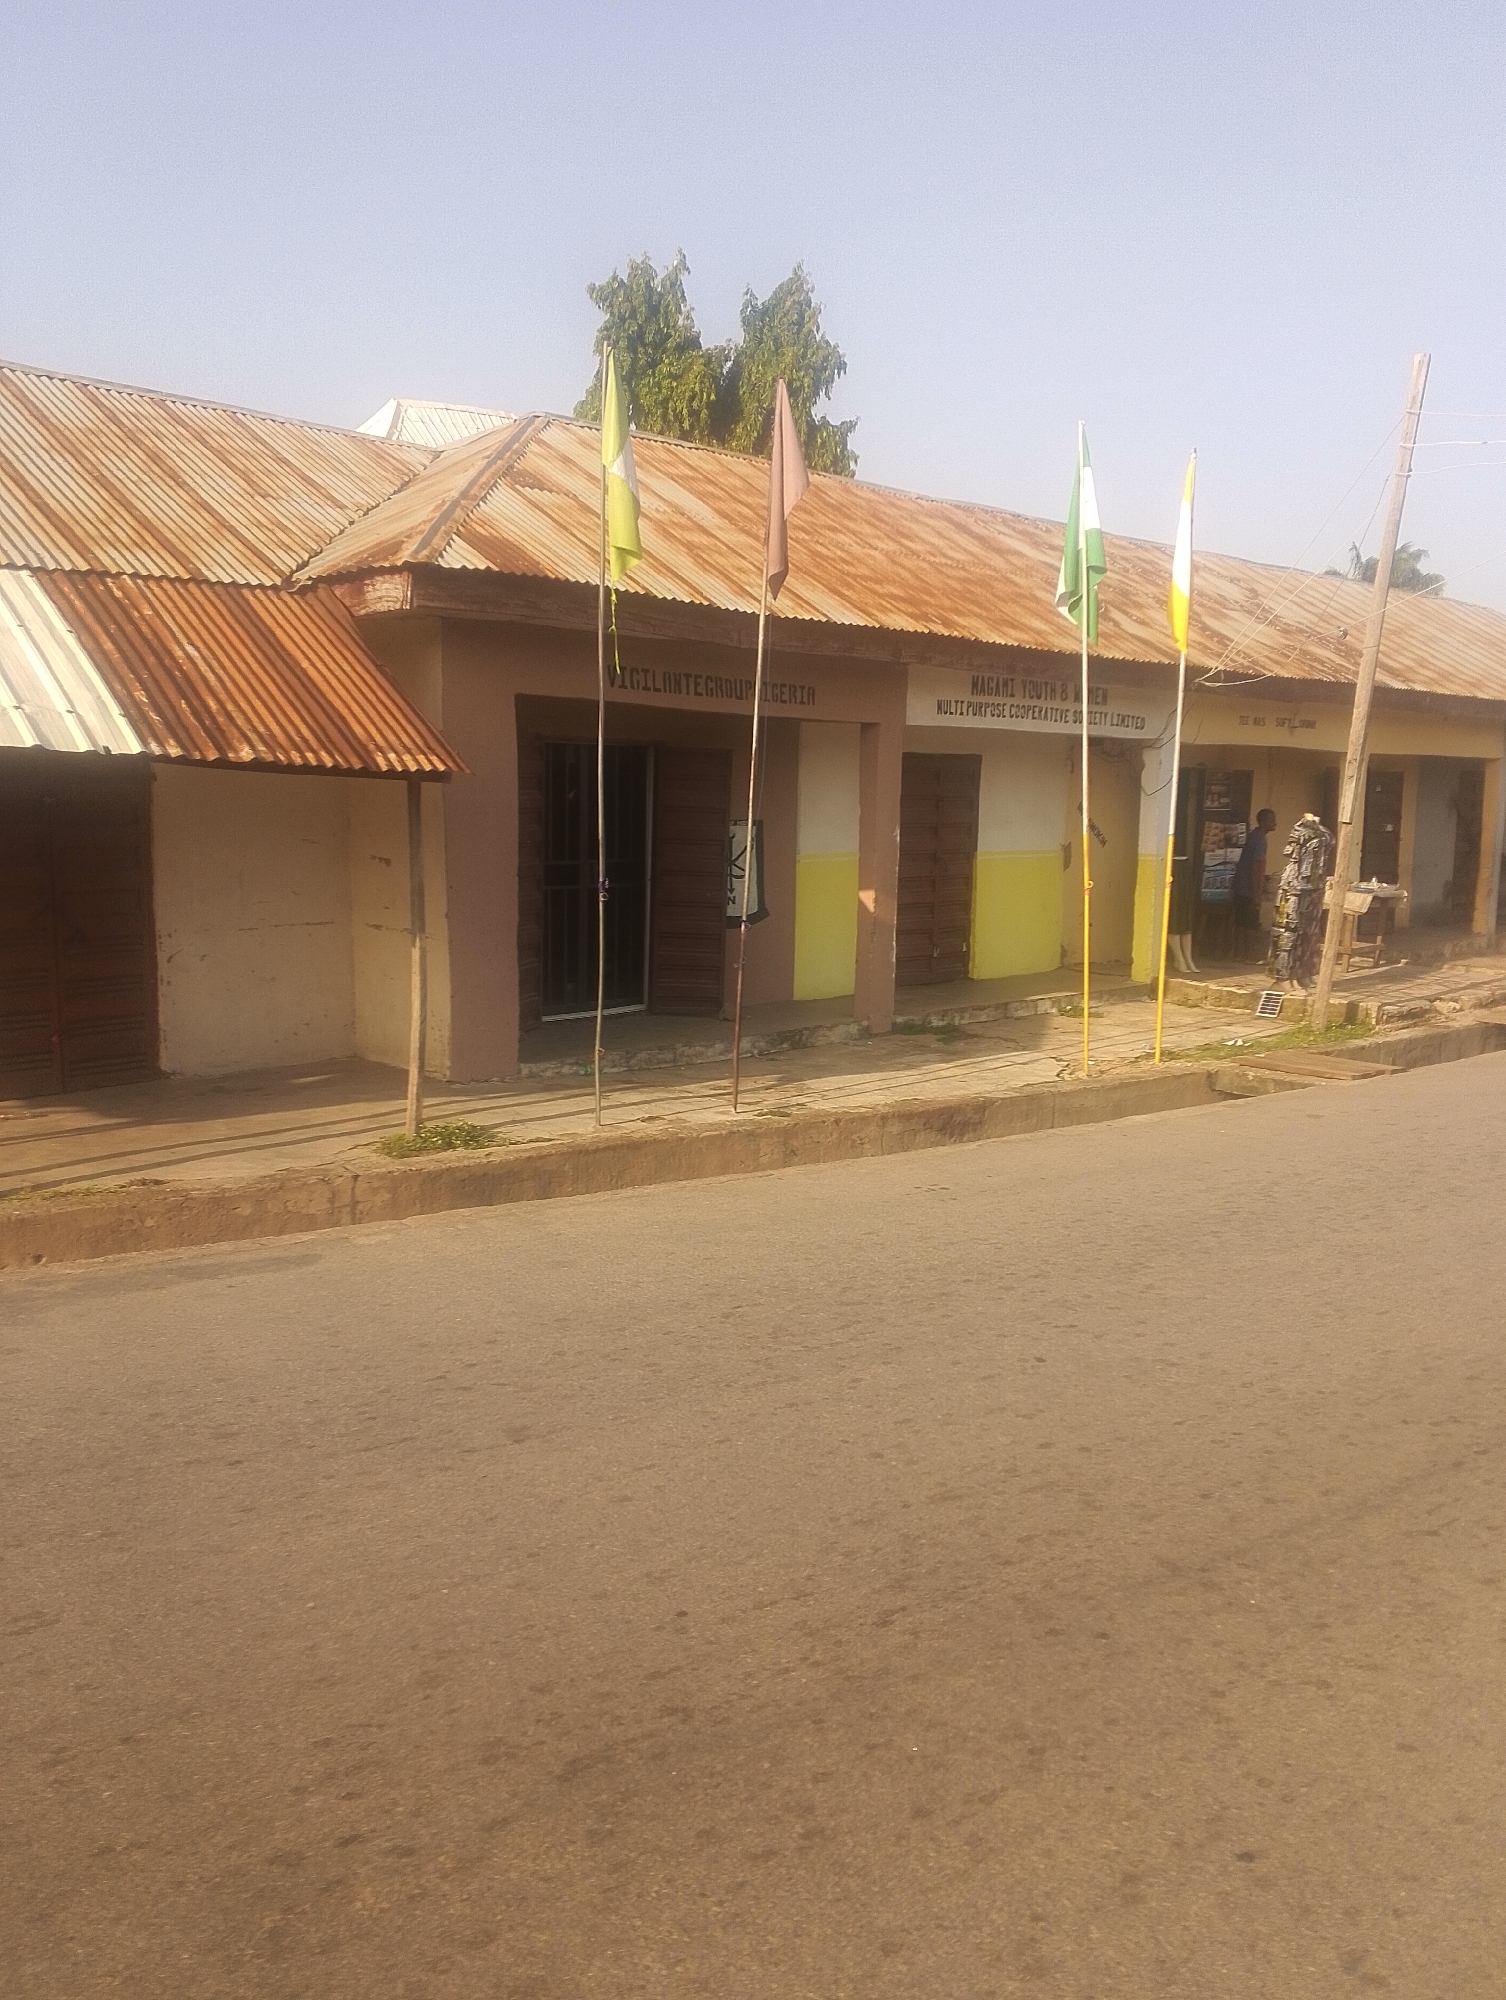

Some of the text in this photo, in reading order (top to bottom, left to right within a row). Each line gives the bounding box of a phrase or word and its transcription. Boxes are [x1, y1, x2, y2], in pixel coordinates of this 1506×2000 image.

[1021, 678, 1056, 701] YOUTH
[1073, 683, 1108, 706] WMEN
[1009, 703, 1070, 724] COOPERATIVE
[1072, 709, 1109, 726] SOIETY
[1110, 712, 1146, 731] LIMITED
